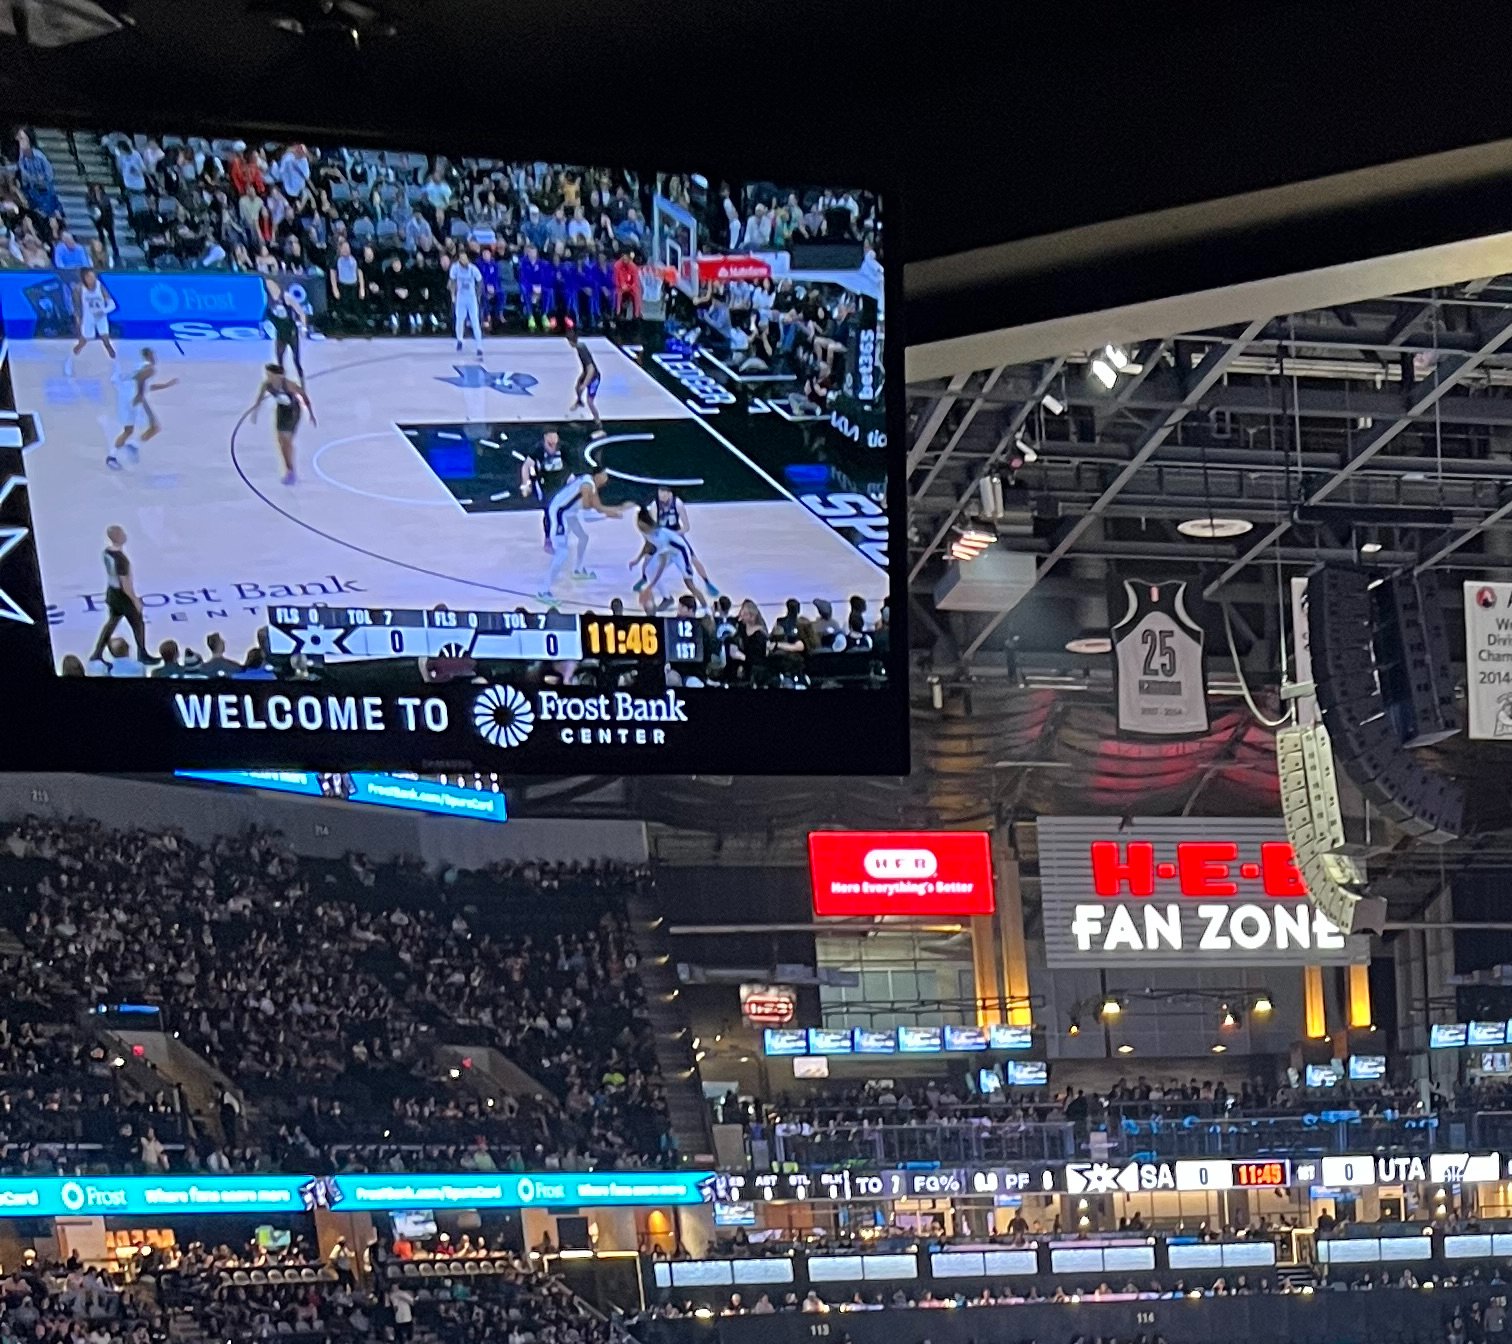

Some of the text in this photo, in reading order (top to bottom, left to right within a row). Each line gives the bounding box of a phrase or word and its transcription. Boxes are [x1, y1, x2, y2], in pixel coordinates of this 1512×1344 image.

[75, 588, 218, 613] Fost
[309, 611, 319, 625] 0
[347, 611, 372, 625] TOL
[383, 611, 392, 626] 7
[504, 614, 527, 629] TOL
[537, 614, 546, 629] 7
[677, 621, 693, 638] 12
[390, 630, 405, 653] 0
[546, 633, 559, 656] 0
[587, 622, 659, 654] 11:46
[1141, 629, 1177, 677] 25
[174, 693, 449, 732] WELCOME TO
[538, 690, 689, 722] Frost Bank
[560, 727, 666, 745] CENTER
[1071, 903, 1346, 951] FAN ZONE
[1140, 1163, 1175, 1189] SA
[1199, 1167, 1208, 1185] 0
[1238, 1163, 1282, 1185] 11:45
[1344, 1163, 1354, 1181] 0
[1377, 1157, 1426, 1182] UTA
[856, 1176, 883, 1194] TO
[913, 1175, 961, 1193] FG%
[1005, 1173, 1030, 1190] PF
[86, 1186, 128, 1206] Frost
